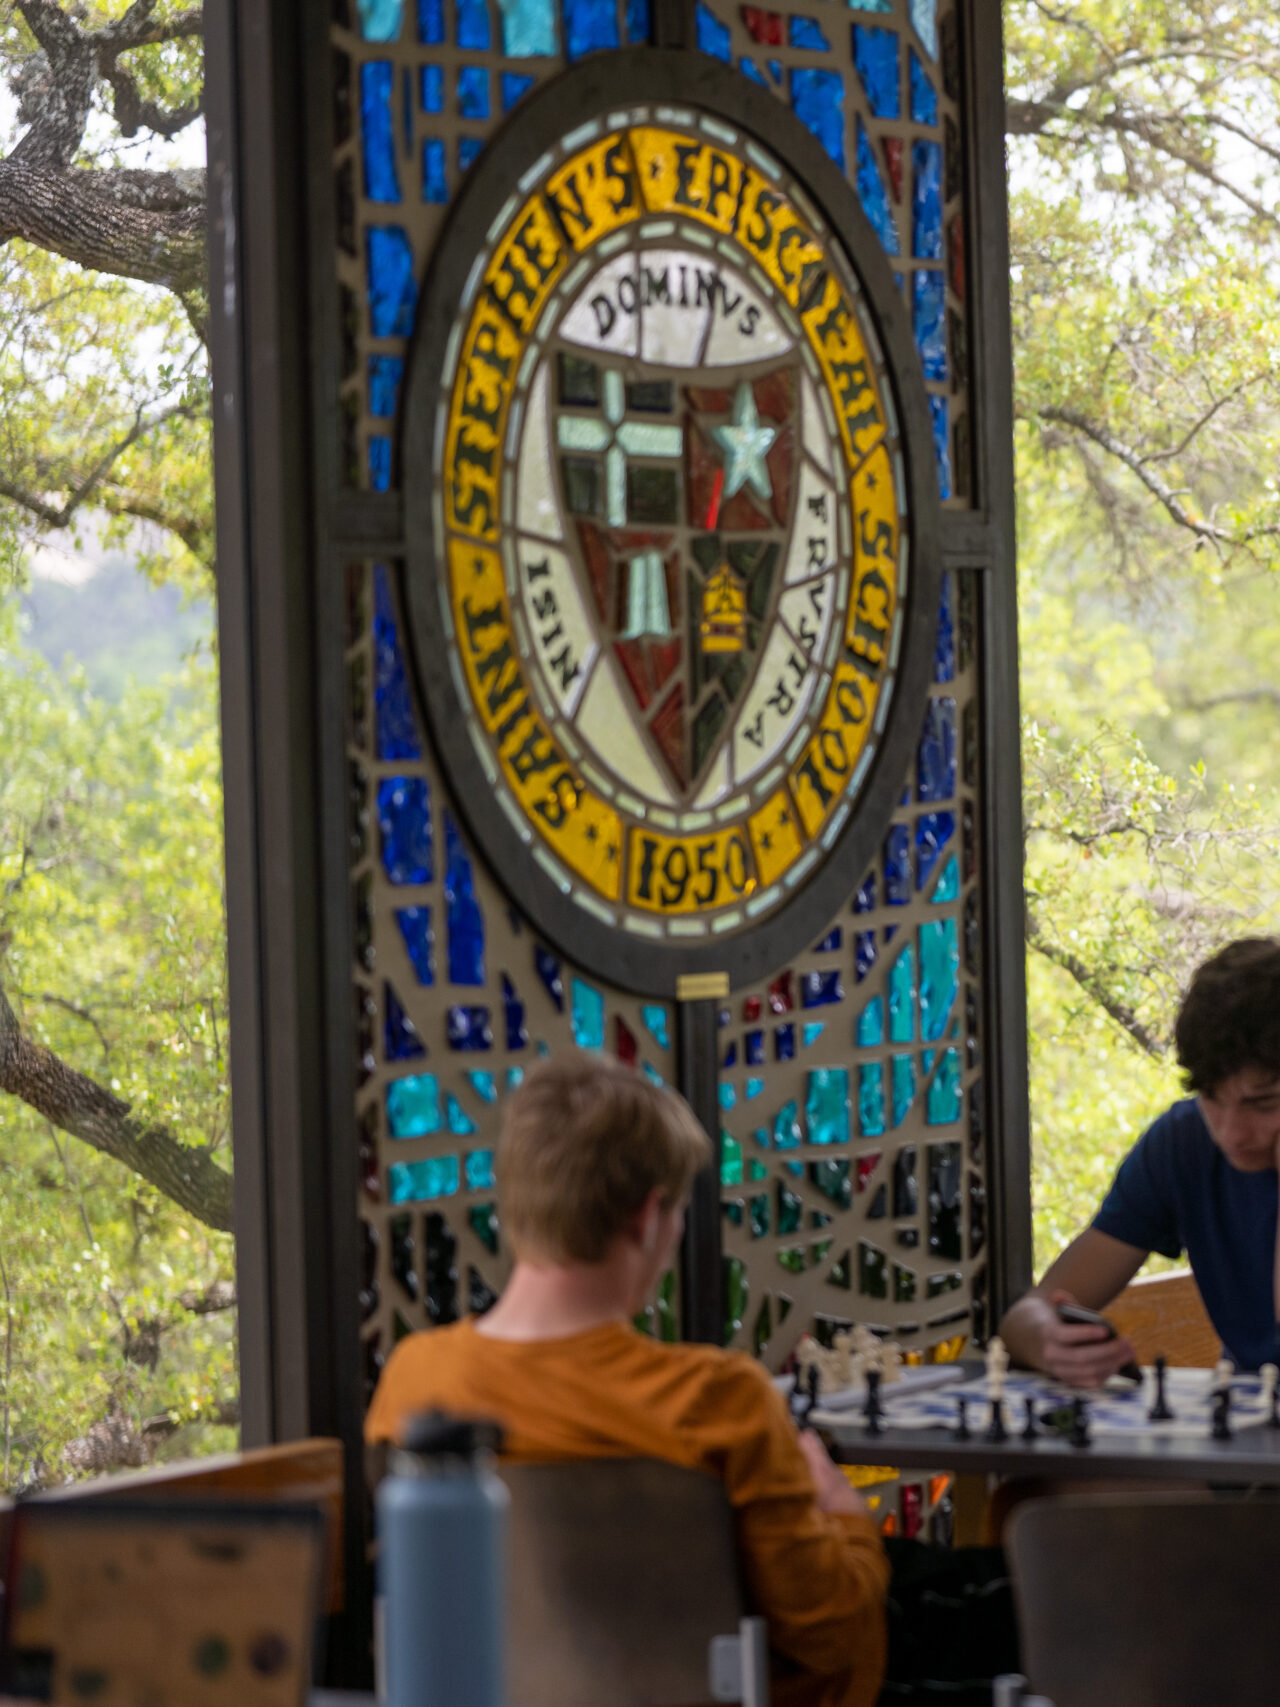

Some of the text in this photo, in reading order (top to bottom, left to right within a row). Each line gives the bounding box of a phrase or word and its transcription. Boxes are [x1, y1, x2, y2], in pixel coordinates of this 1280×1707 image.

[453, 145, 636, 533] STEPHEN'S
[527, 265, 828, 749] NISI DOMINVS FRVSTRA
[463, 595, 582, 829] SAINT
[796, 508, 896, 809] SCHOOL
[637, 835, 749, 907] 1950
